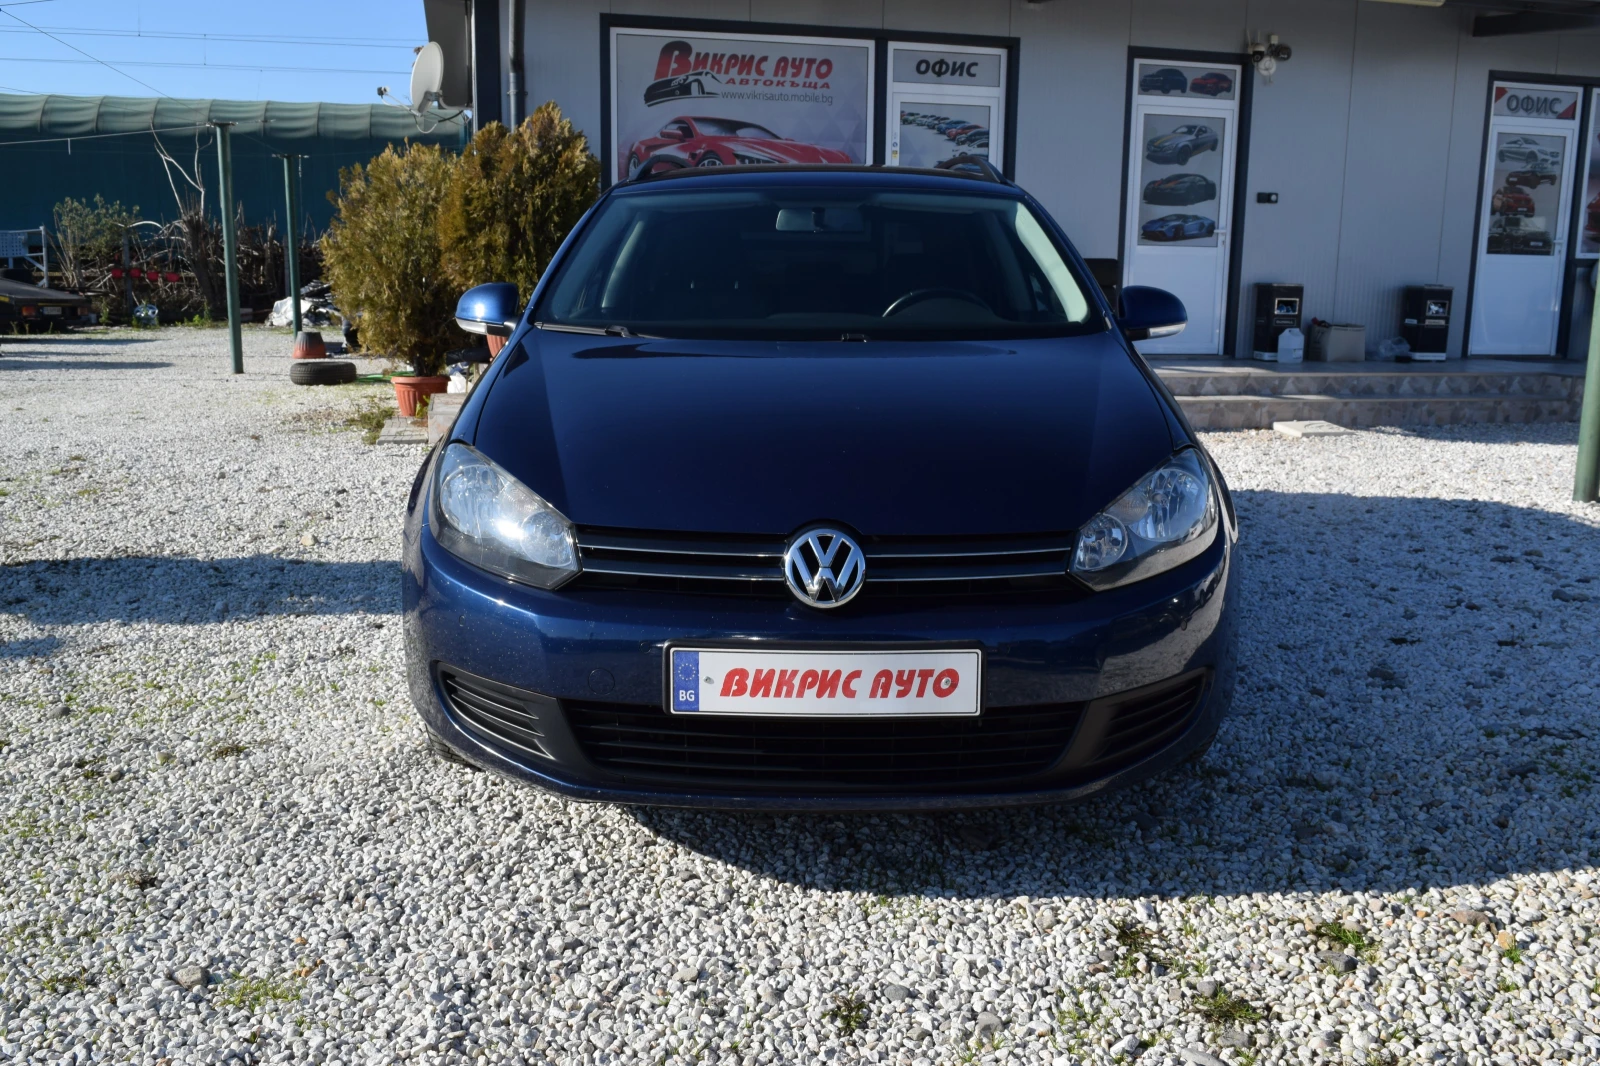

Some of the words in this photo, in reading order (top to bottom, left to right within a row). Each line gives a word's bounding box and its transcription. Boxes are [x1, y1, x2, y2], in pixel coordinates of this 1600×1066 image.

[773, 56, 833, 79] АУТО
[915, 58, 979, 77] ОФИС
[725, 77, 831, 89] АВТОКЪЩА
[721, 90, 833, 106] www.vikrisauto.mobile.bg
[1506, 94, 1562, 115] ОФИС
[720, 667, 862, 699] ВИКРИС
[869, 668, 960, 698] АУТО
[679, 690, 695, 702] BG
